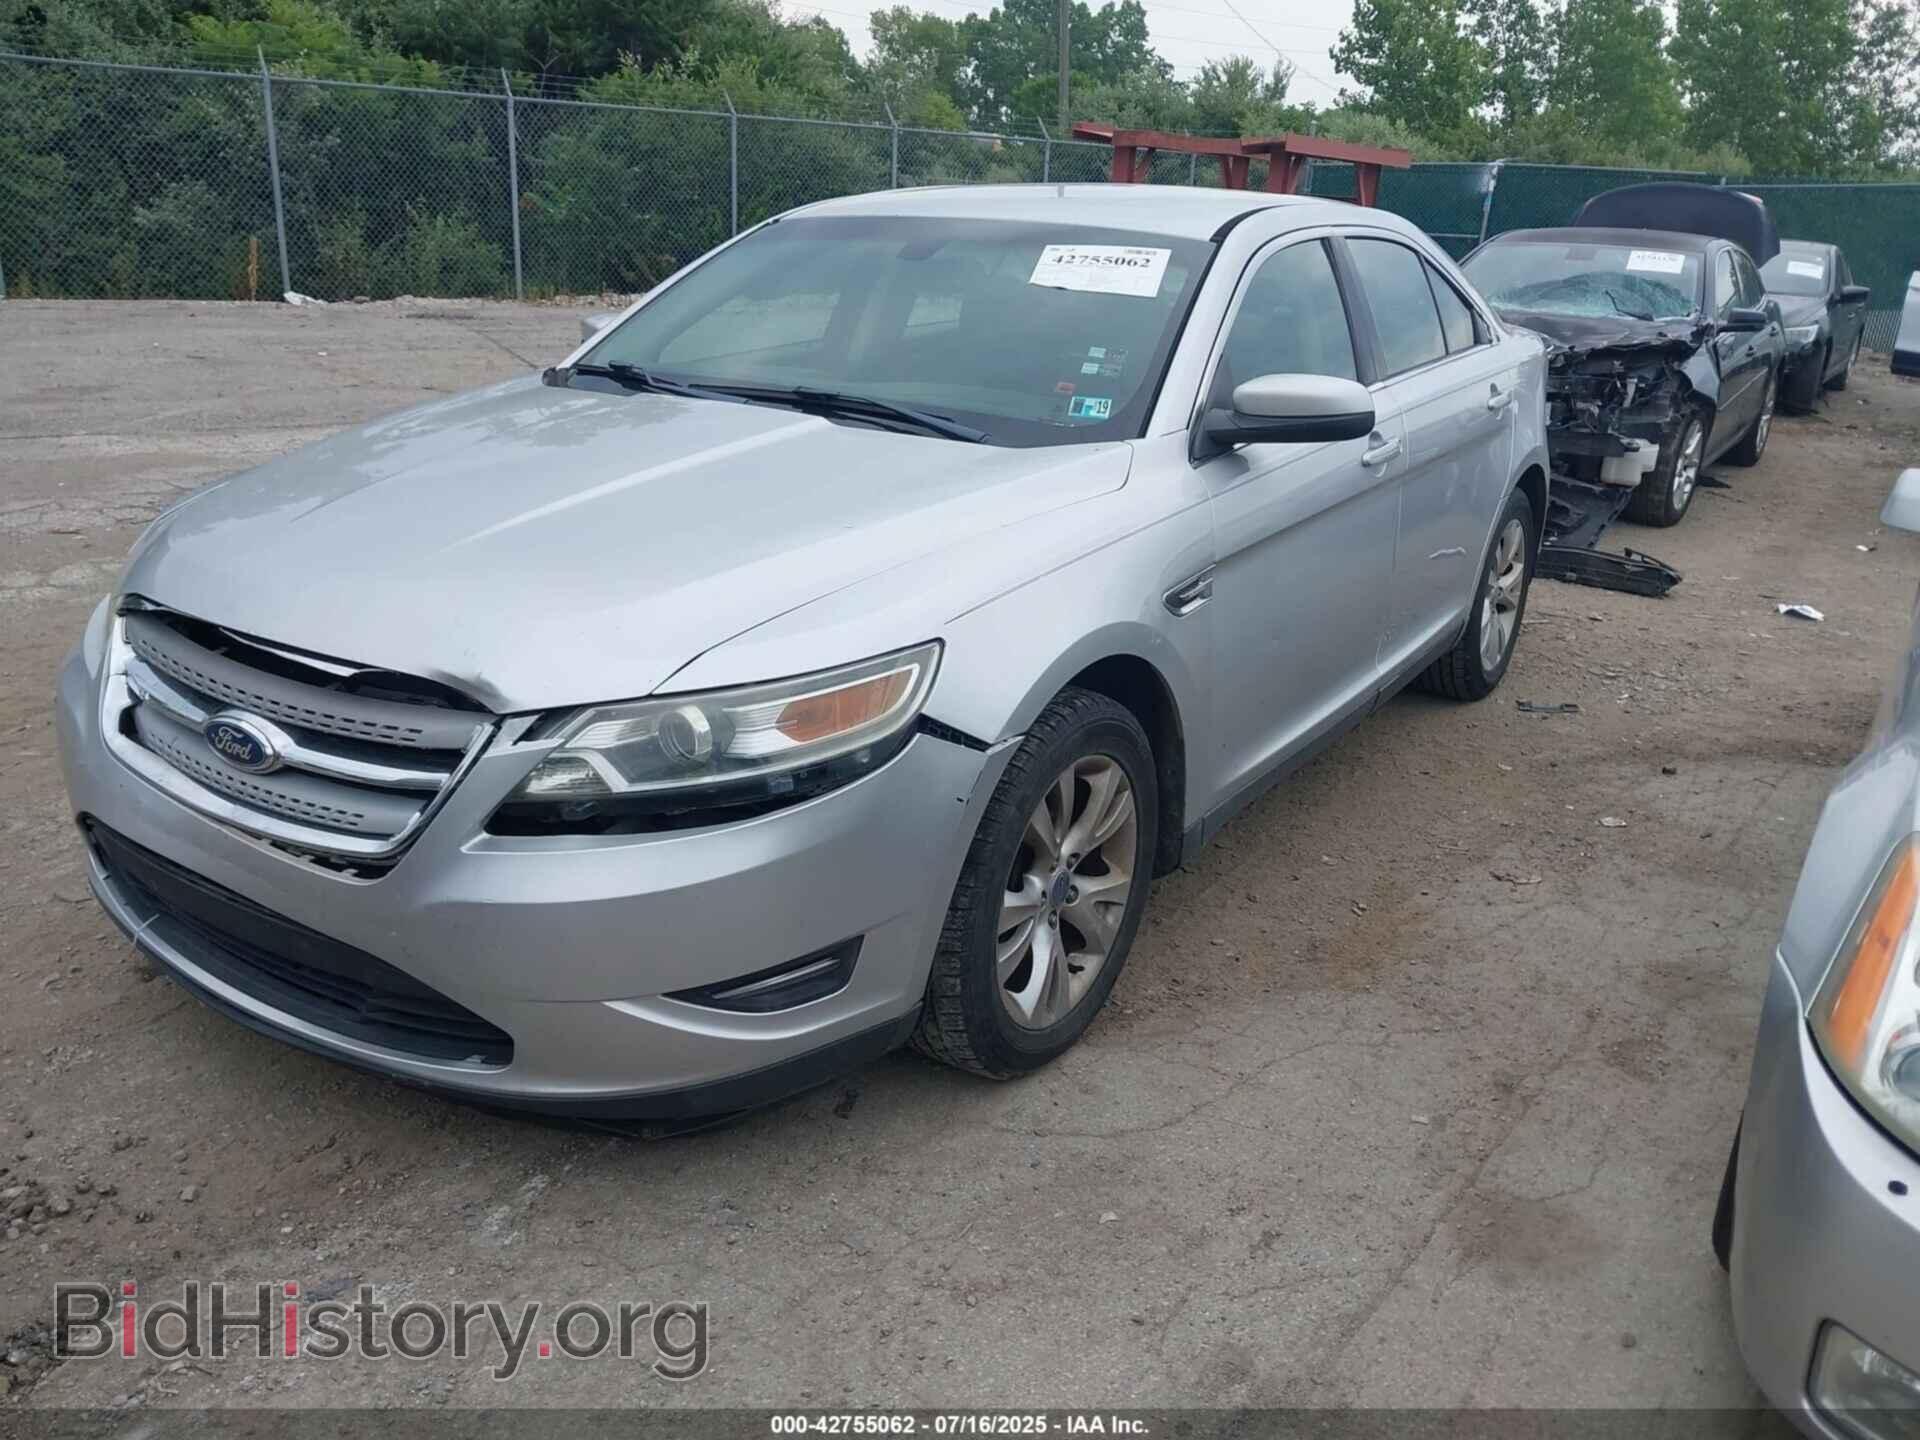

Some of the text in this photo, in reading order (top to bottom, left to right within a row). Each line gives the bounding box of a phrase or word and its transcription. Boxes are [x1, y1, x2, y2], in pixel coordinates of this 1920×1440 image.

[1052, 255, 1151, 267] 42755062
[1097, 400, 1109, 413] 19
[214, 726, 253, 760] Ford
